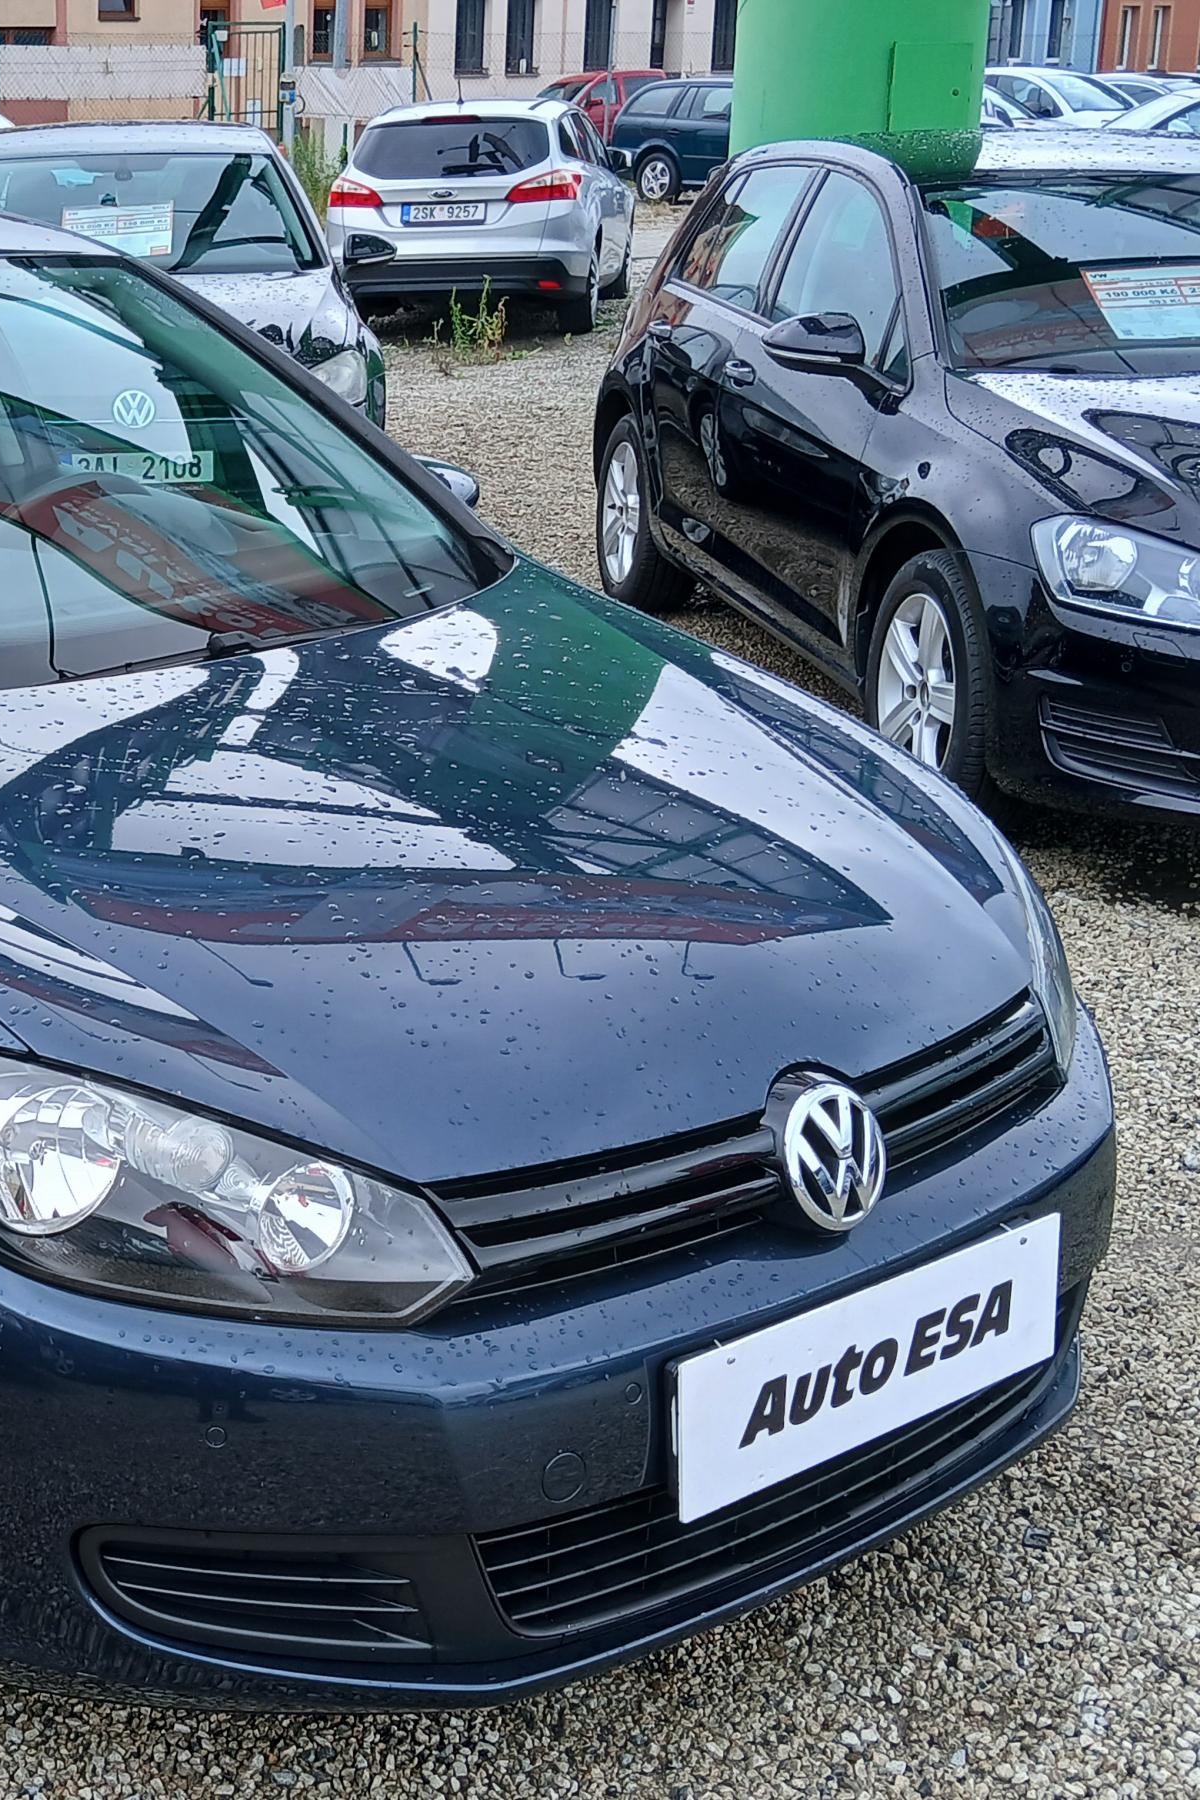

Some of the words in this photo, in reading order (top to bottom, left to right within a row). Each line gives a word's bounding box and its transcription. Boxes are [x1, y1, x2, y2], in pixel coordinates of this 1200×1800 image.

[412, 206, 437, 220] 2SK
[447, 205, 480, 219] 9257
[142, 455, 202, 480] 2108
[739, 1335, 899, 1449] Auto
[903, 1279, 1013, 1377] ESA
